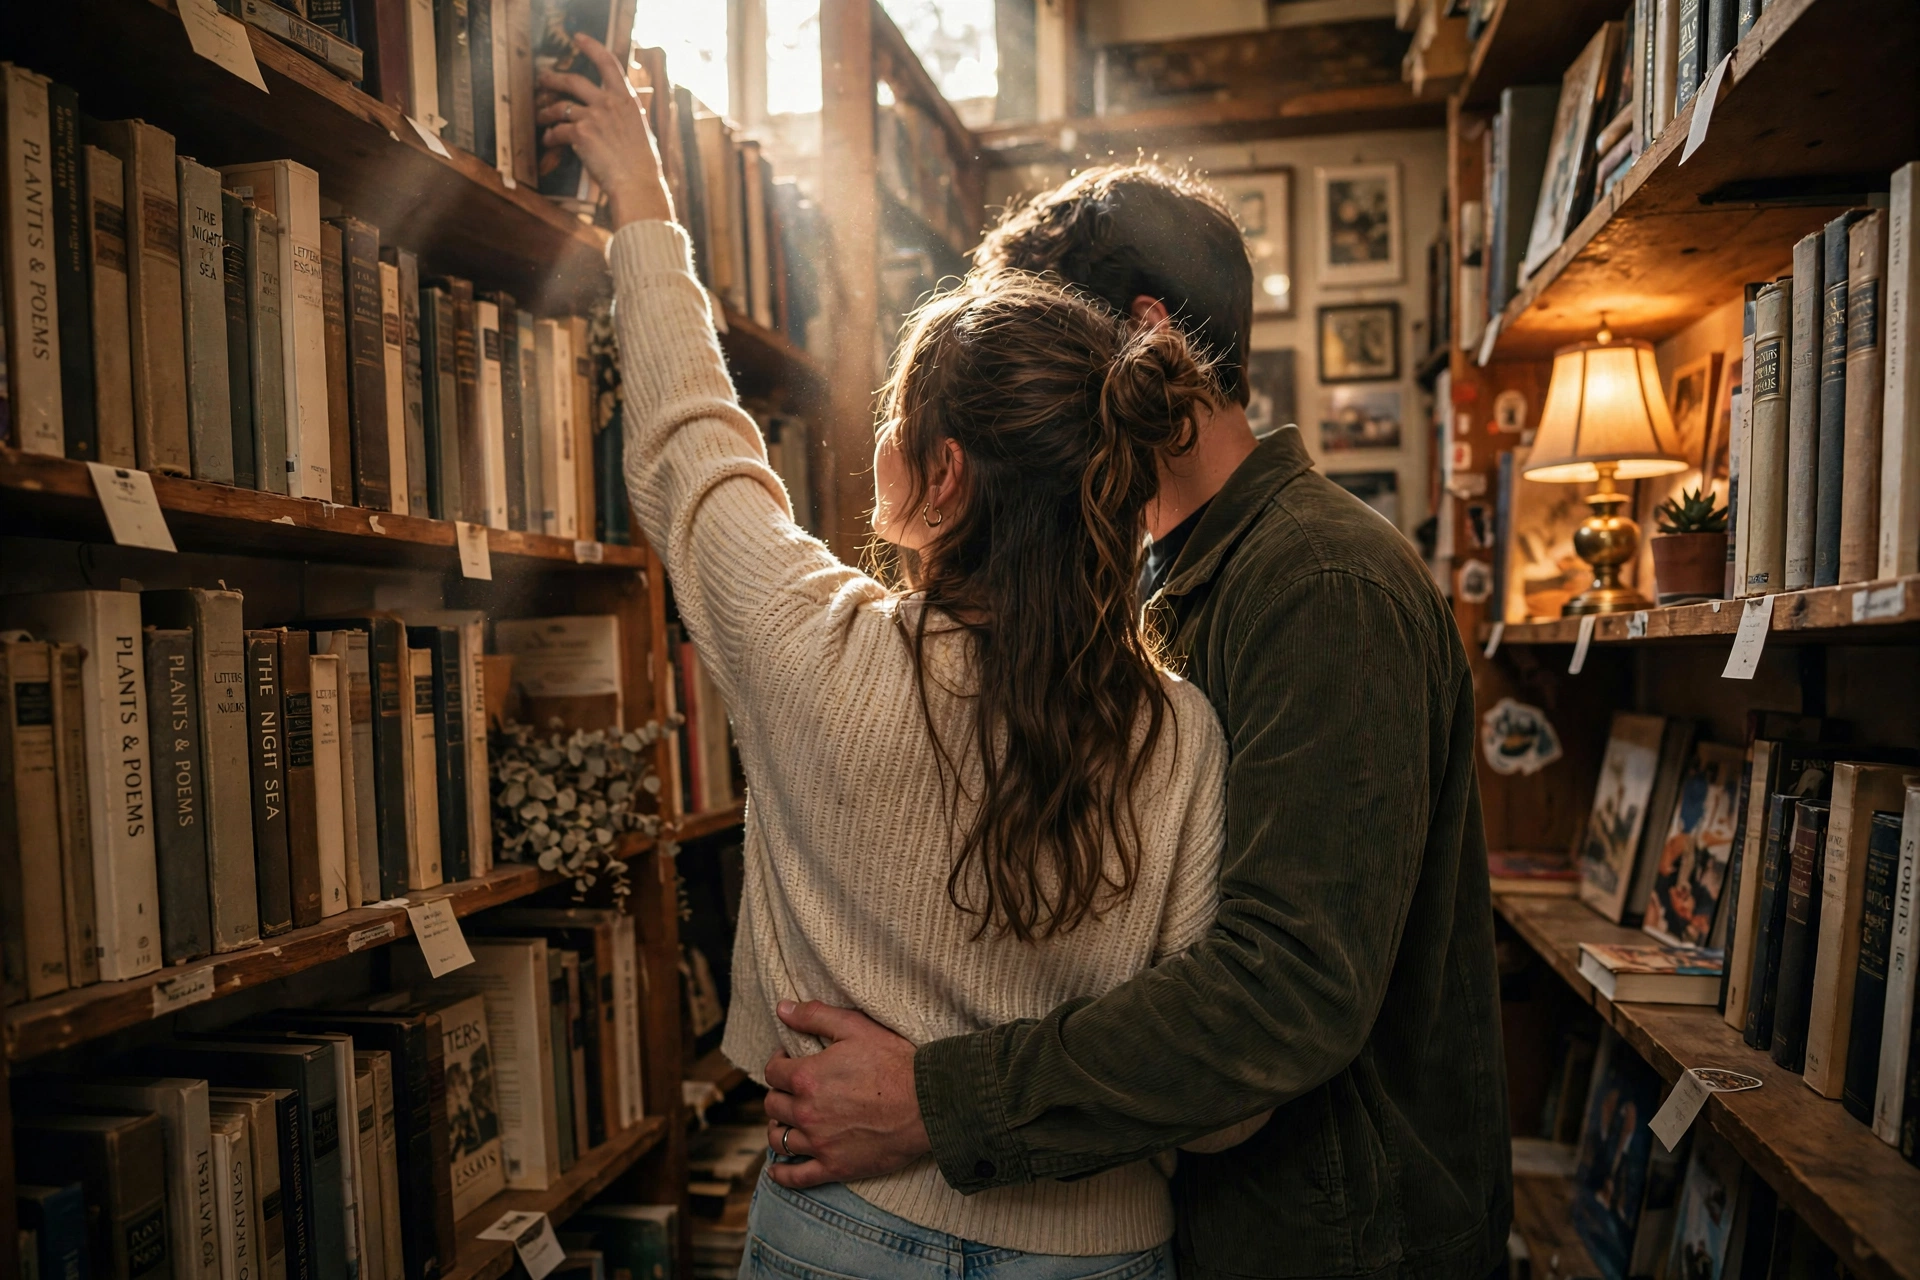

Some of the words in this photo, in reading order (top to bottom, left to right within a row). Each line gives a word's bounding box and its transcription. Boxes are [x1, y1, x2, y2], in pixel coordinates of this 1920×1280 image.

[196, 206, 216, 226] THE
[28, 257, 46, 272] &
[200, 262, 217, 280] SEA
[30, 281, 50, 360] POEMS
[116, 636, 138, 725] PLANTS
[168, 655, 188, 731] PLANTS
[258, 653, 274, 697] THE
[122, 735, 139, 752] &
[175, 738, 190, 752] &
[123, 758, 144, 838] POEMS
[175, 760, 194, 827] POEMS
[264, 779, 280, 821] SEA
[442, 1019, 481, 1053] TERS
